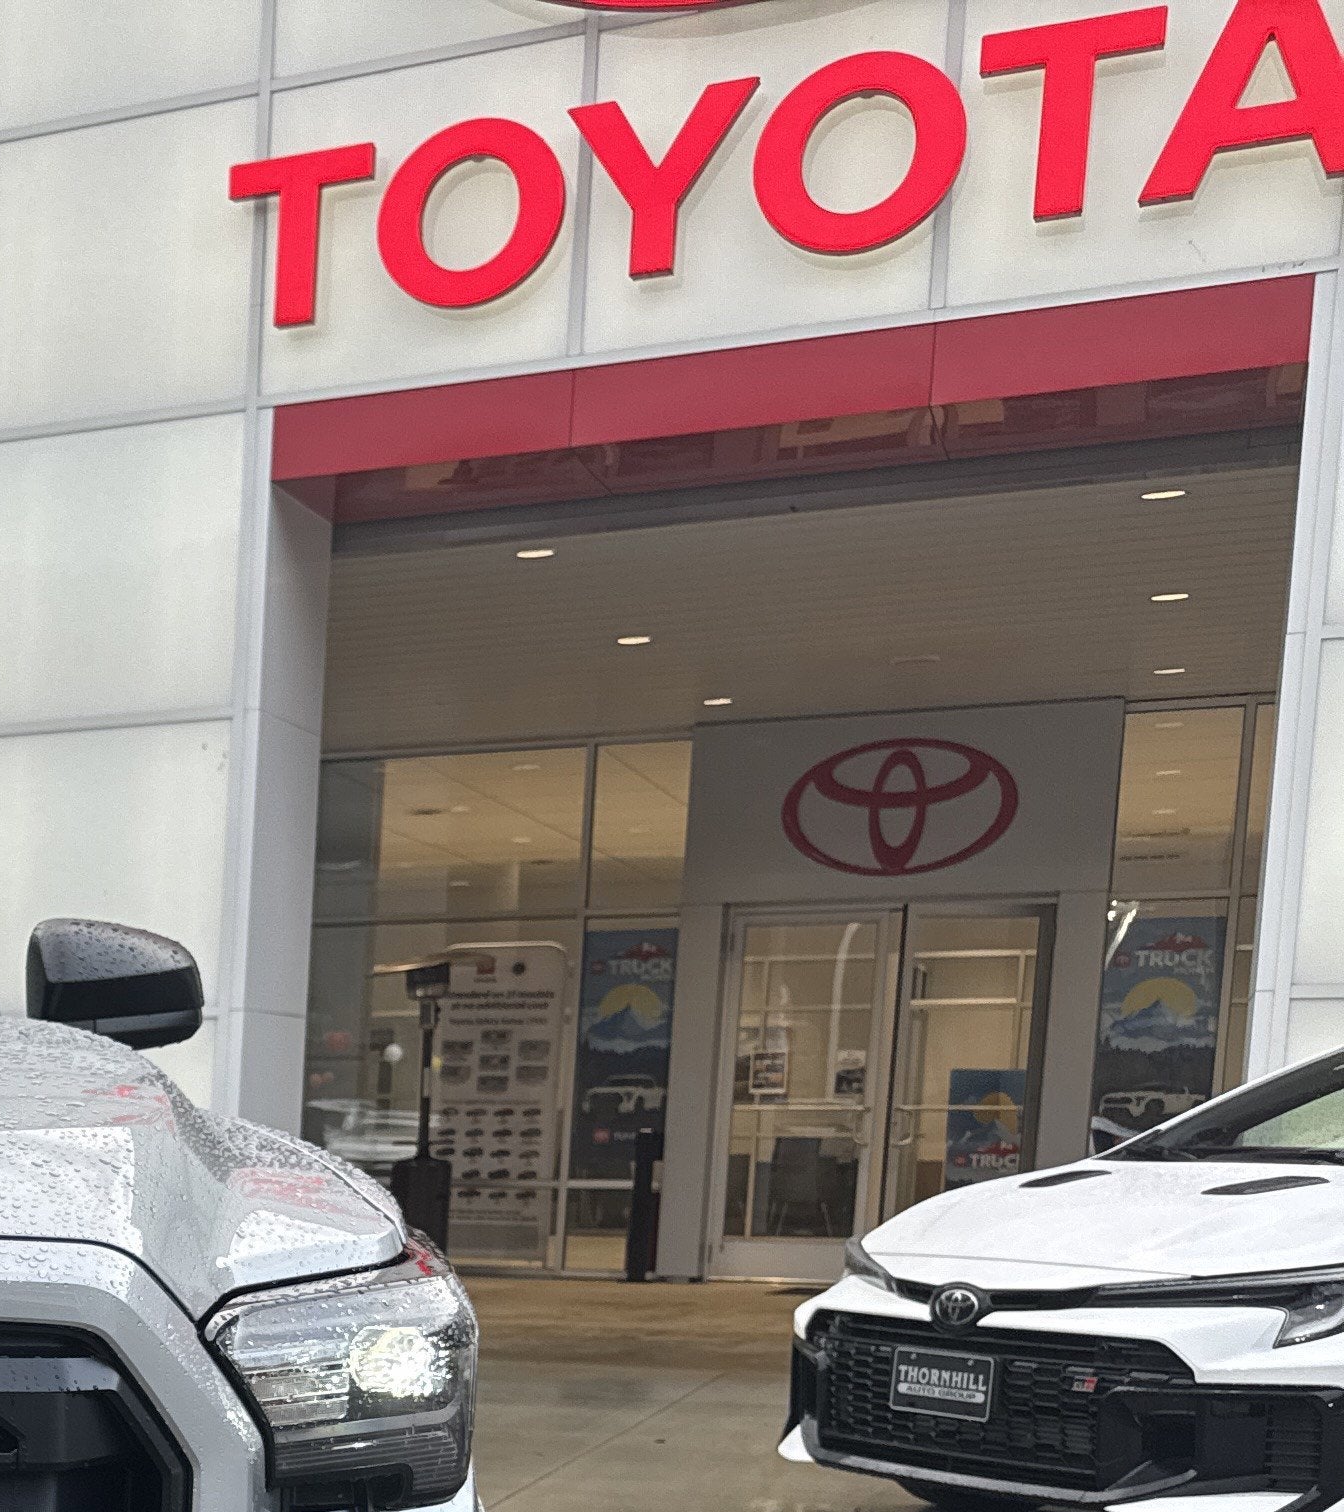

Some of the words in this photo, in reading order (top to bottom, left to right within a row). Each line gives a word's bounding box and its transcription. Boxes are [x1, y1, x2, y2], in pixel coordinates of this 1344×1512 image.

[229, 0, 1344, 328] TOYOTA
[607, 957, 673, 977] TRUCK
[1134, 948, 1214, 968] TRUCK
[898, 1364, 987, 1391] THORNHILL
